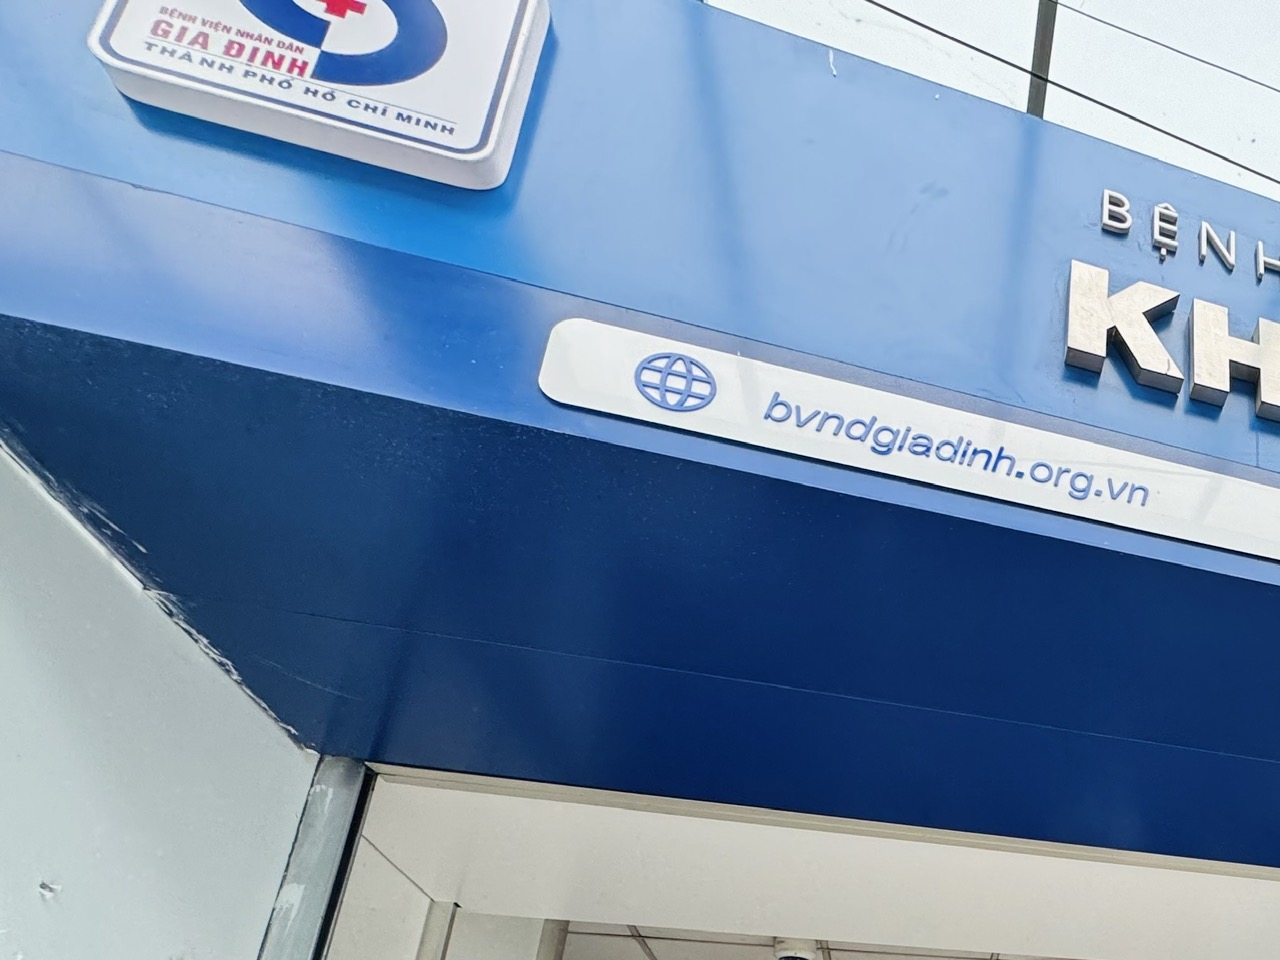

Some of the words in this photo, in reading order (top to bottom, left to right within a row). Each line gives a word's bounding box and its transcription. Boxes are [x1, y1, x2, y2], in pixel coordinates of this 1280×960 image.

[150, 19, 210, 50] GIA
[223, 39, 309, 78] ĐỊNH
[159, 6, 198, 24] BỆNH
[201, 17, 232, 35] VIỆN
[236, 28, 274, 46] NHÂN
[276, 40, 304, 55] DÂN
[144, 41, 234, 74] THÀNH
[243, 69, 294, 90] PHỐ
[347, 99, 388, 116] CHÍ
[395, 111, 456, 135] MINH
[763, 391, 1150, 508] bvndgiadinh.org.vn
